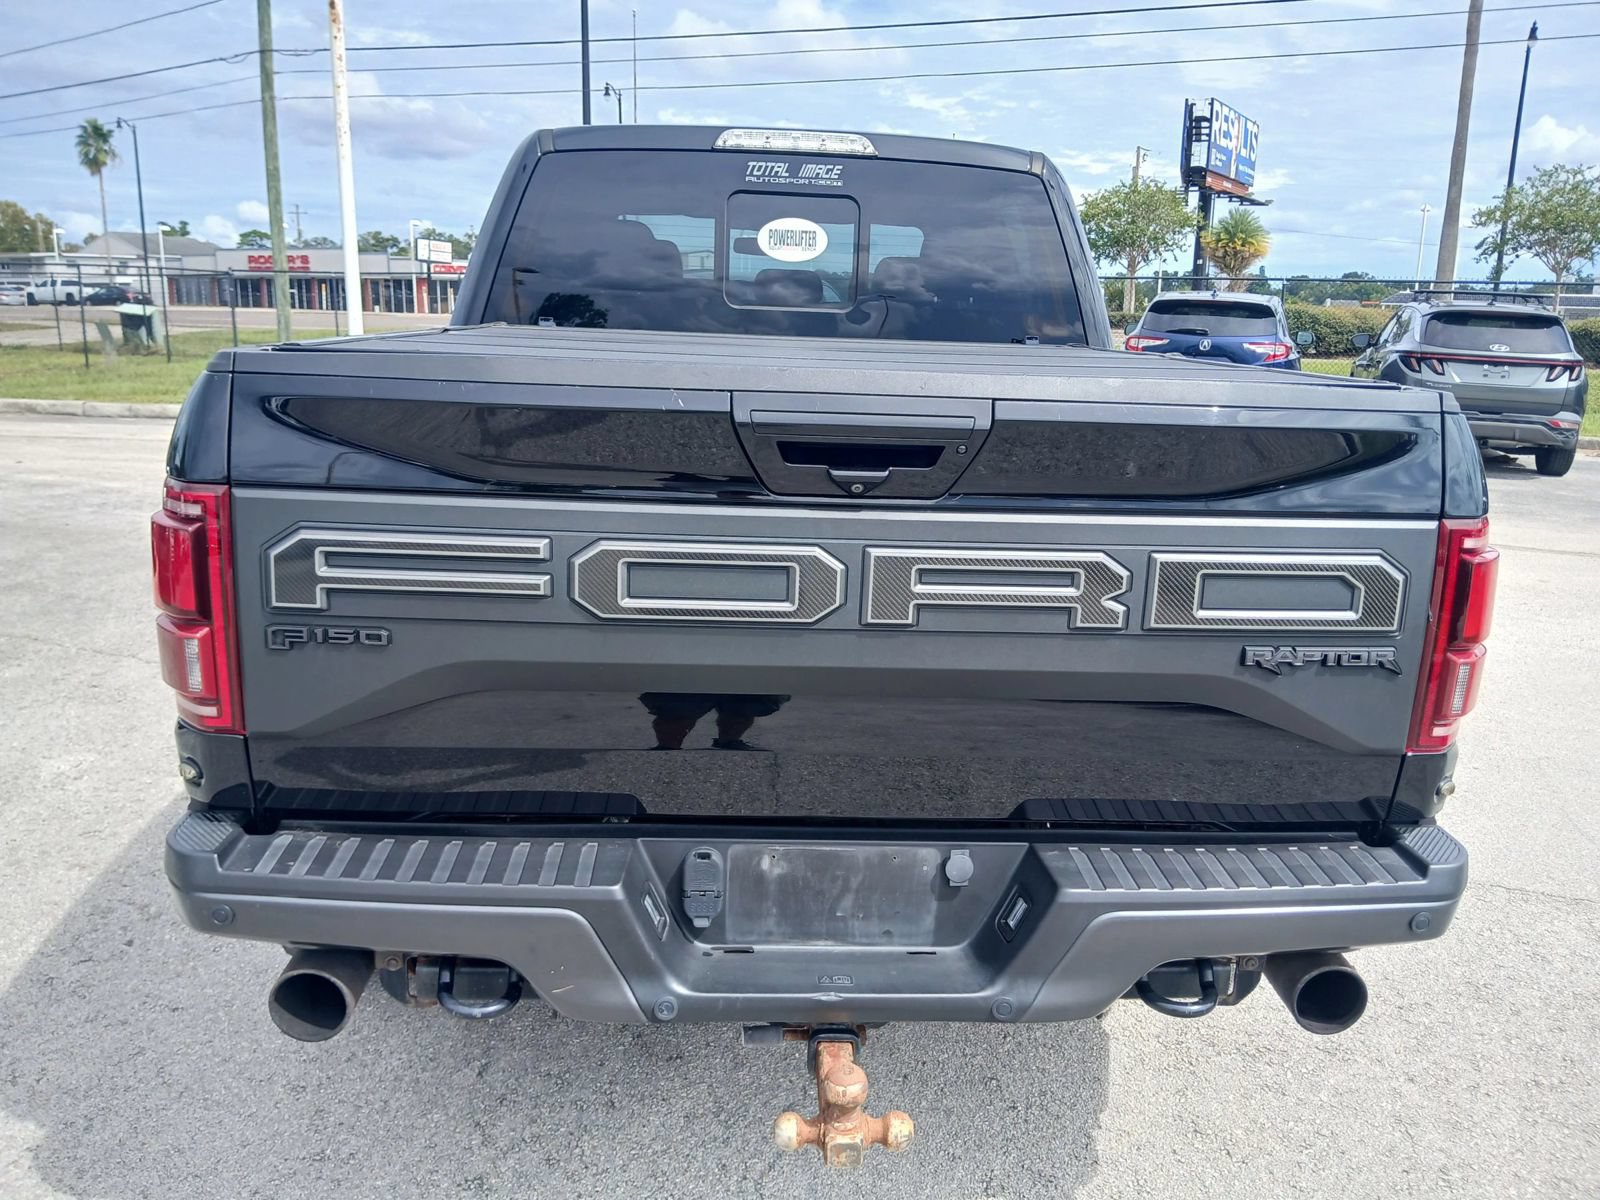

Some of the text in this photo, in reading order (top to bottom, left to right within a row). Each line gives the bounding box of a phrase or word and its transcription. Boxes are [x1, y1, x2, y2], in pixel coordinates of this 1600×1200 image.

[746, 161, 843, 179] TOTAL IMAGE
[768, 229, 817, 247] POWERLIFTER
[265, 526, 1408, 634] FORD
[1241, 645, 1401, 675] RAPTOR
